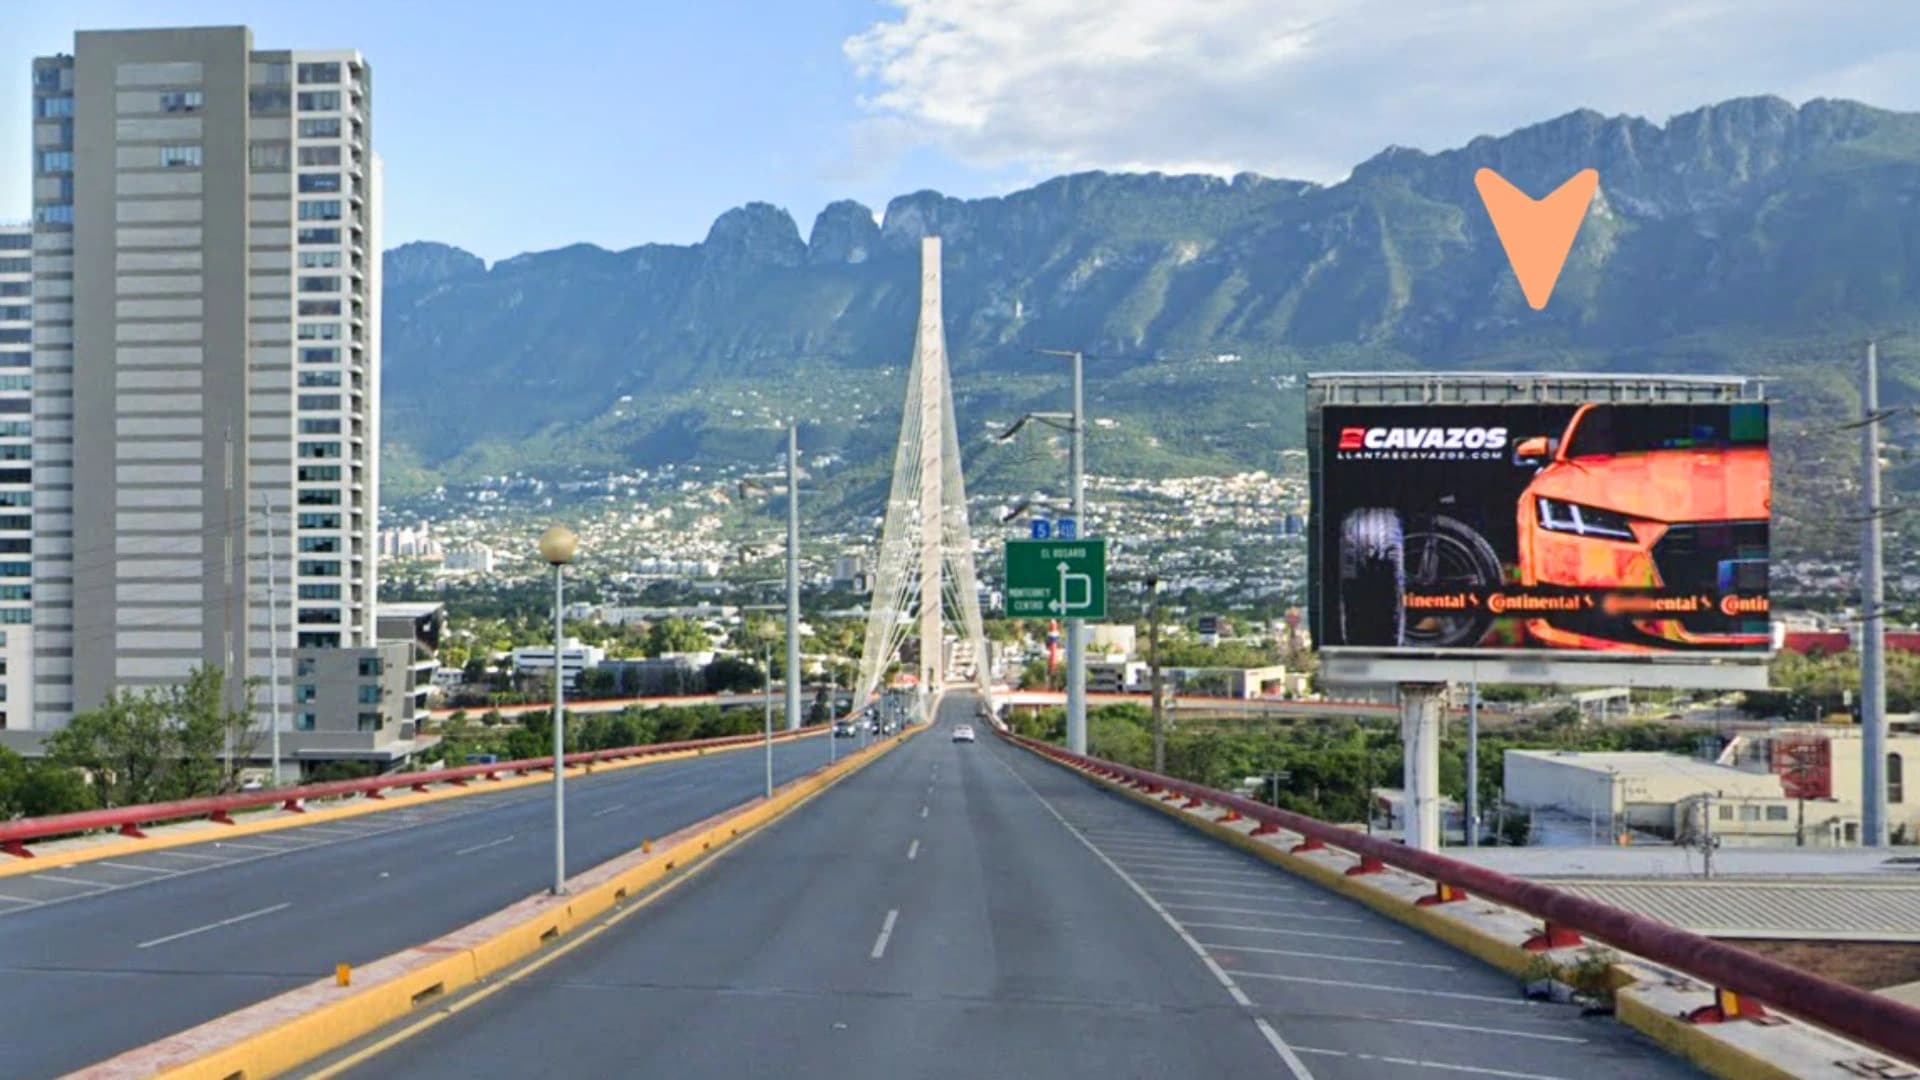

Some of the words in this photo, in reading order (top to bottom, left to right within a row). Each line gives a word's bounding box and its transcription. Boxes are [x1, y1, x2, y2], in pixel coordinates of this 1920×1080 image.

[1364, 427, 1507, 449] CAVAZOS
[1337, 451, 1503, 460] LLANTASCAVAZOS.COM
[1487, 592, 1581, 614] Continental
